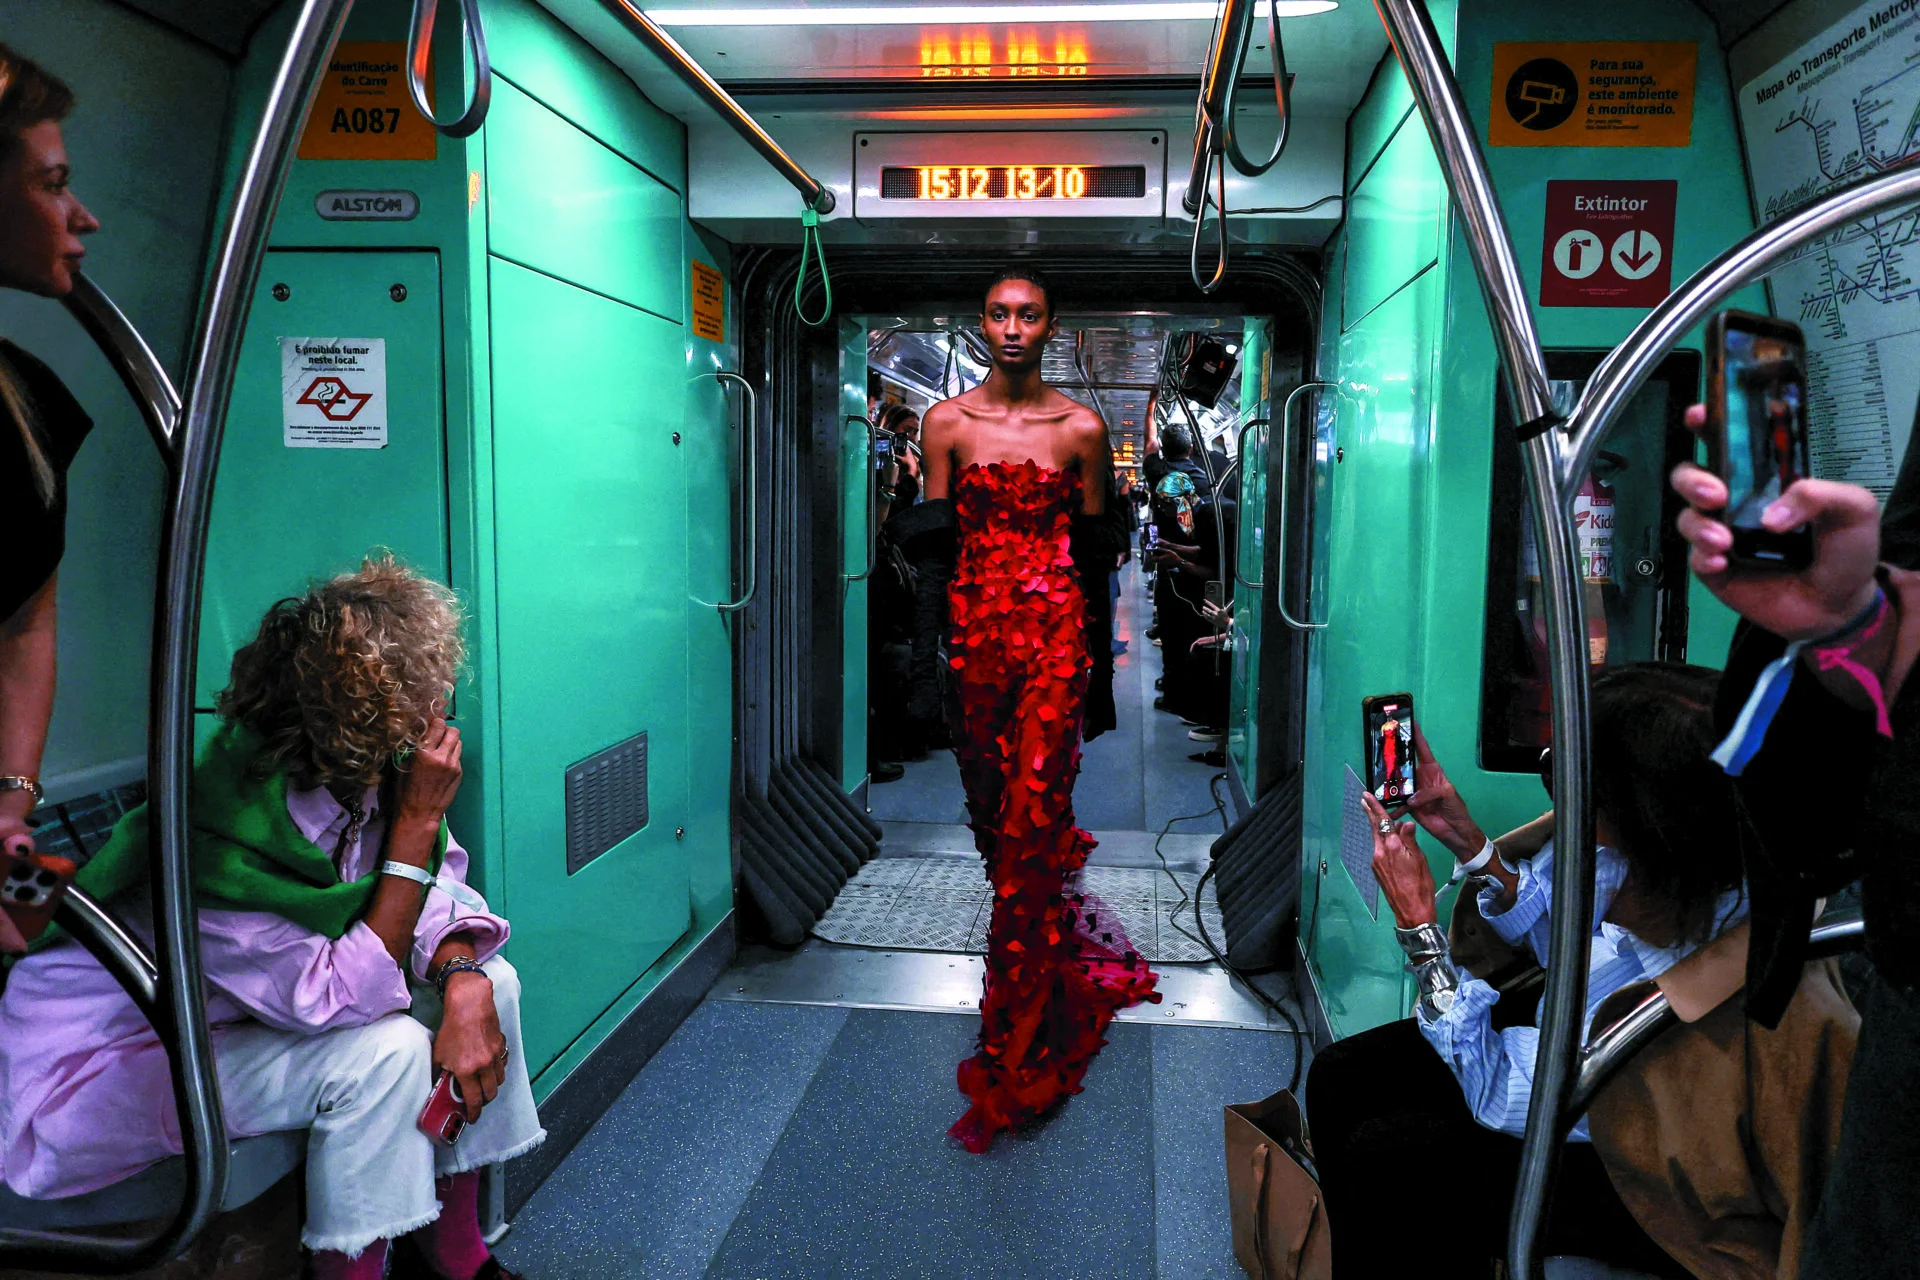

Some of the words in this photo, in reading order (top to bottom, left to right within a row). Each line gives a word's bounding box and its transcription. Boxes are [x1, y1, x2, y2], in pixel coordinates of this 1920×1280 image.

[329, 61, 398, 75] Identificação
[1590, 59, 1618, 70] Para
[1621, 60, 1644, 70] sua
[1756, 80, 1784, 105] Mapa
[1786, 69, 1801, 85] do
[1801, 25, 1867, 75] Transporte
[341, 75, 355, 86] do
[358, 76, 388, 86] Carro
[1588, 75, 1656, 88] segurança,
[1588, 89, 1615, 100] este
[1618, 88, 1678, 100] ambiente
[1586, 103, 1594, 114] é
[1598, 103, 1676, 115] monitorado.
[330, 107, 400, 134] A087
[919, 168, 989, 200] 15:12
[1005, 167, 1085, 200] 13/10
[331, 197, 402, 213] ALSTOM
[1574, 195, 1648, 211] Extintor
[303, 345, 340, 355] proibido
[343, 345, 369, 354] fumar
[308, 356, 332, 364] neste
[334, 356, 358, 364] local.
